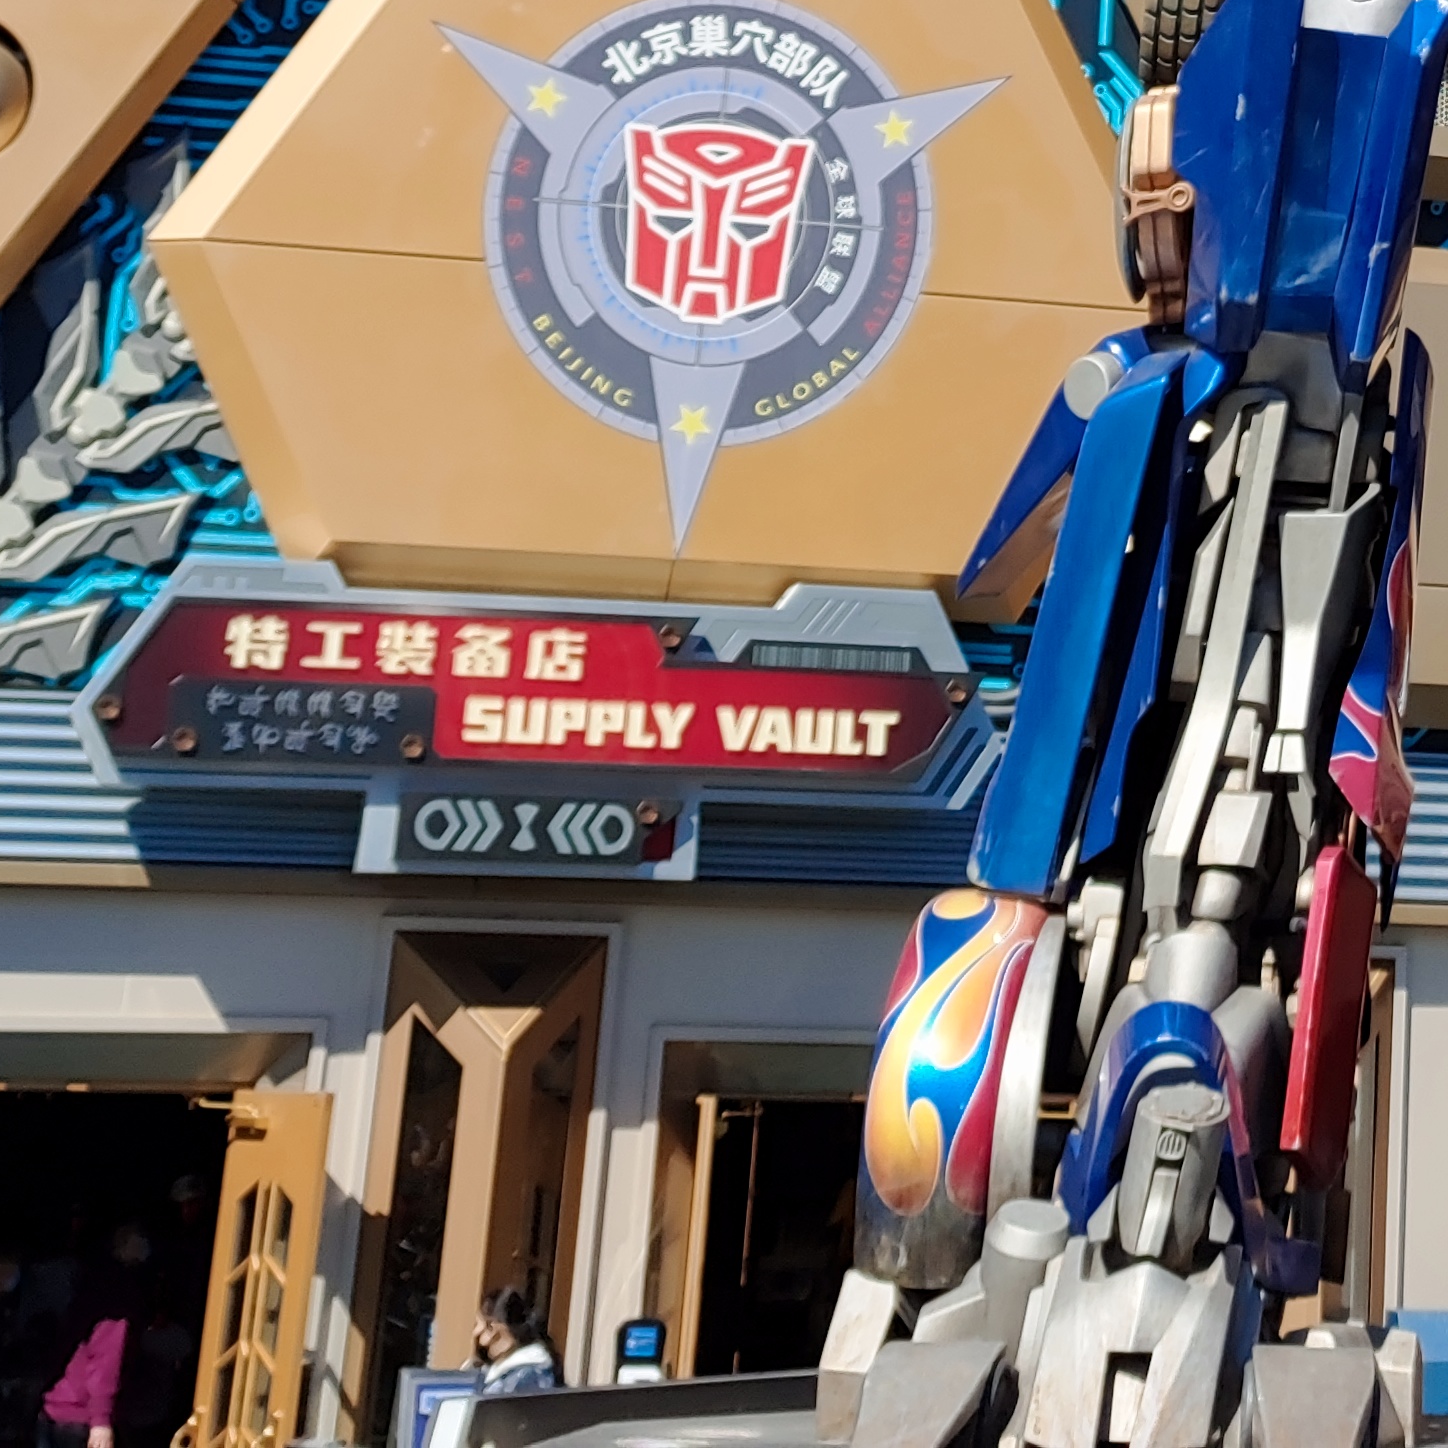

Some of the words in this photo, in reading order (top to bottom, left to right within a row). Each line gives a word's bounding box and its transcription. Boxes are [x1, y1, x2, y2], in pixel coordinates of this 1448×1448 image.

[602, 14, 851, 109] 北京巢穴部队
[814, 157, 858, 296] 全球联盟
[754, 345, 859, 417] GLOBAL
[863, 191, 914, 336] ALLIANCE
[532, 312, 636, 408] BEIJING
[461, 694, 696, 749] SUPPLY
[717, 705, 901, 757] VAULT
